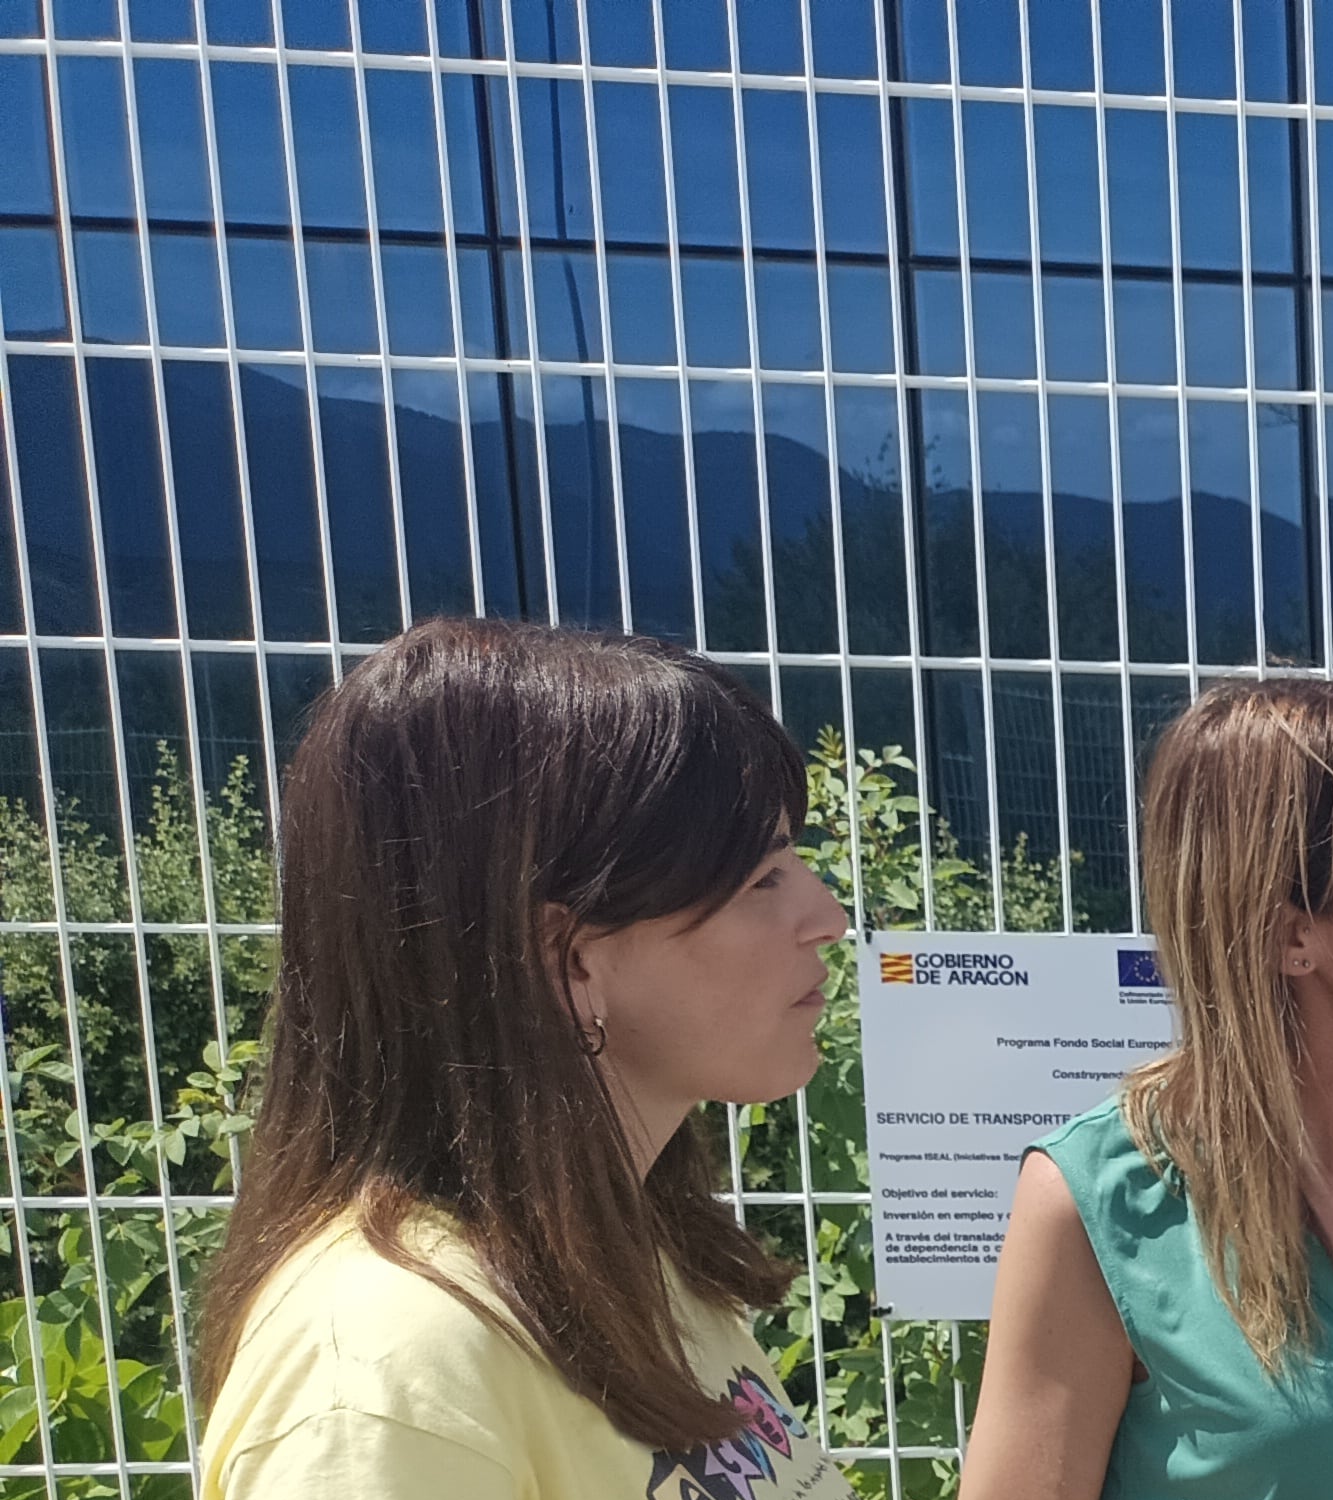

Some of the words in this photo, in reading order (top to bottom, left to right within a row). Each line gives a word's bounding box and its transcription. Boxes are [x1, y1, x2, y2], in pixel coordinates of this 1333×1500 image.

[915, 953, 1014, 969] GOBIERNO
[915, 970, 941, 984] DE
[947, 970, 1029, 986] ARAGON
[996, 1037, 1050, 1050] Programa
[1053, 1038, 1089, 1048] Fondo
[1091, 1038, 1125, 1048] Social
[876, 1112, 946, 1124] SERVICIO
[949, 1113, 970, 1125] DE
[879, 1153, 922, 1162] Programa
[924, 1153, 952, 1161] ISEAL
[953, 1153, 1001, 1162] (Iniciativas
[1003, 1153, 1021, 1161] Soc
[882, 1188, 928, 1200] Objetivo
[931, 1189, 948, 1198] del
[951, 1189, 998, 1198] servicio:
[883, 1211, 935, 1220] Inversión
[937, 1212, 951, 1220] en
[954, 1212, 994, 1222] empleo
[996, 1213, 1004, 1222] y
[885, 1233, 893, 1241] A
[896, 1233, 931, 1241] través
[934, 1233, 950, 1241] del
[885, 1244, 900, 1252] de
[904, 1244, 978, 1254] dependencia
[886, 1254, 981, 1264] establecimientos
[983, 1254, 998, 1263] de
